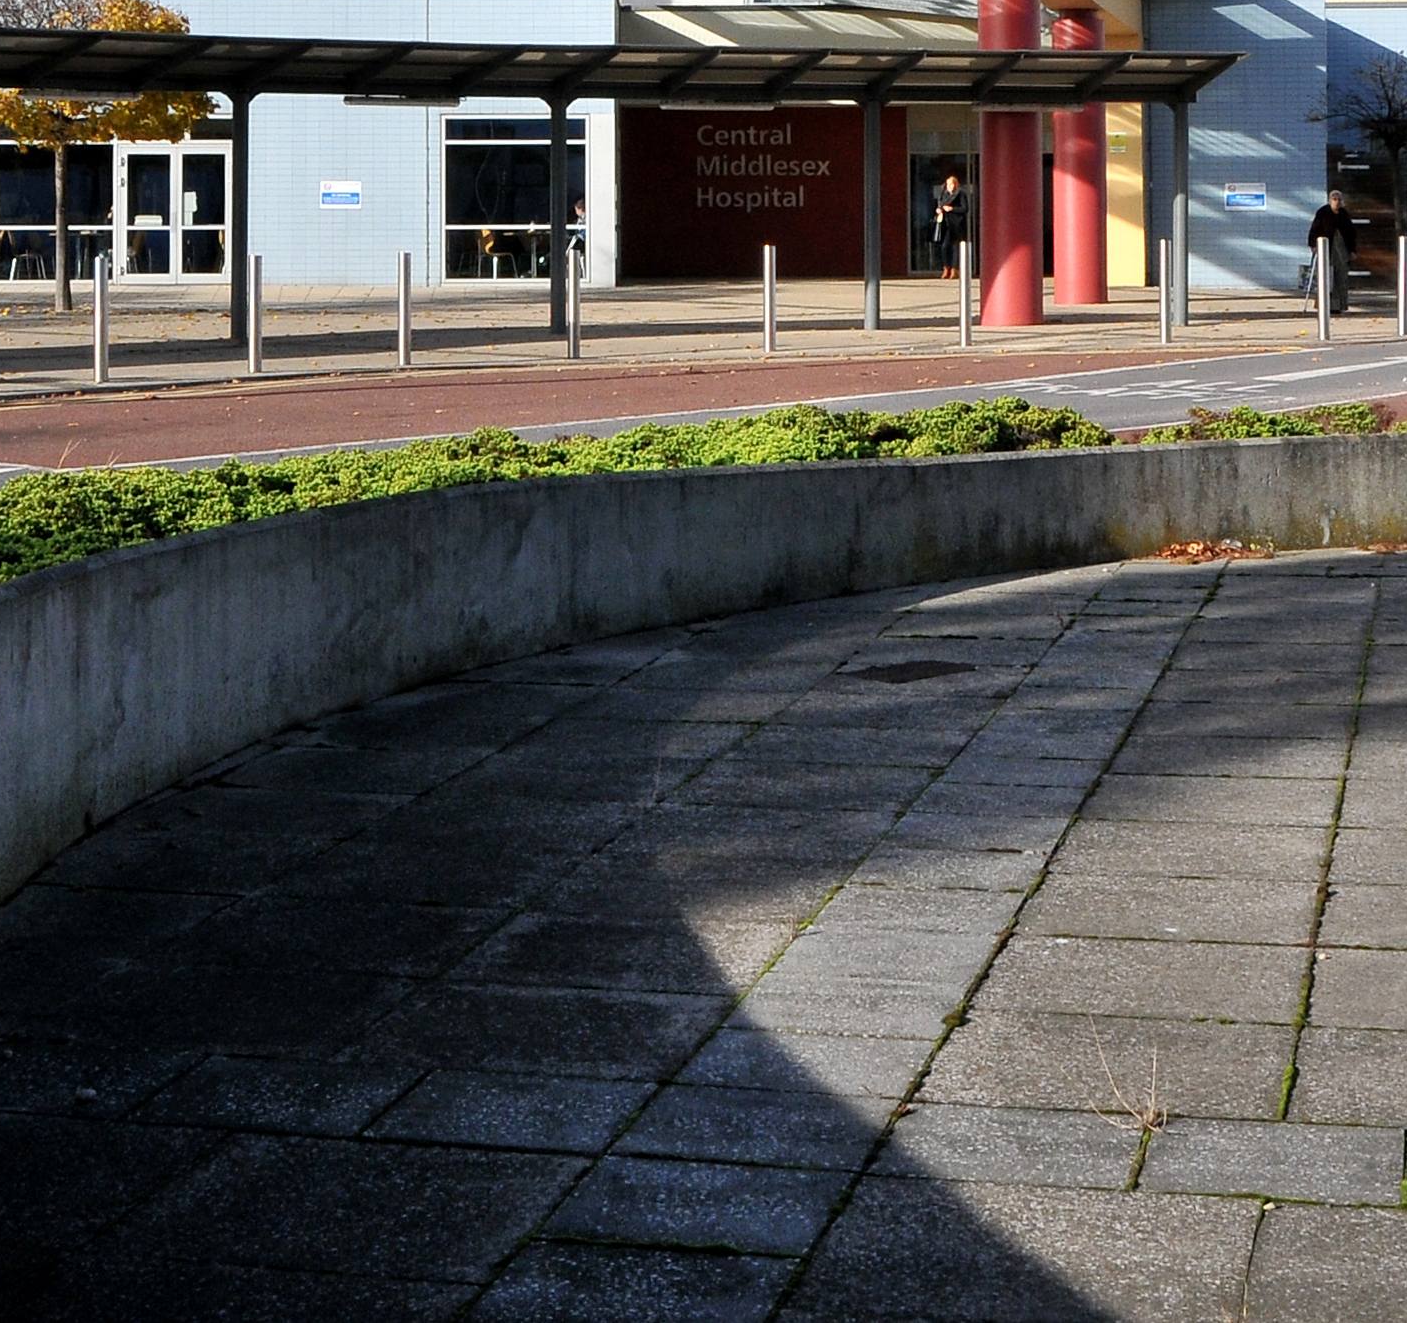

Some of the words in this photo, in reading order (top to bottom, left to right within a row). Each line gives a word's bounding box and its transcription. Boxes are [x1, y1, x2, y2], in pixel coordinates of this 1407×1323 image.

[697, 123, 791, 146] Central
[697, 154, 831, 176] Middlesex
[697, 185, 804, 213] Hospital
